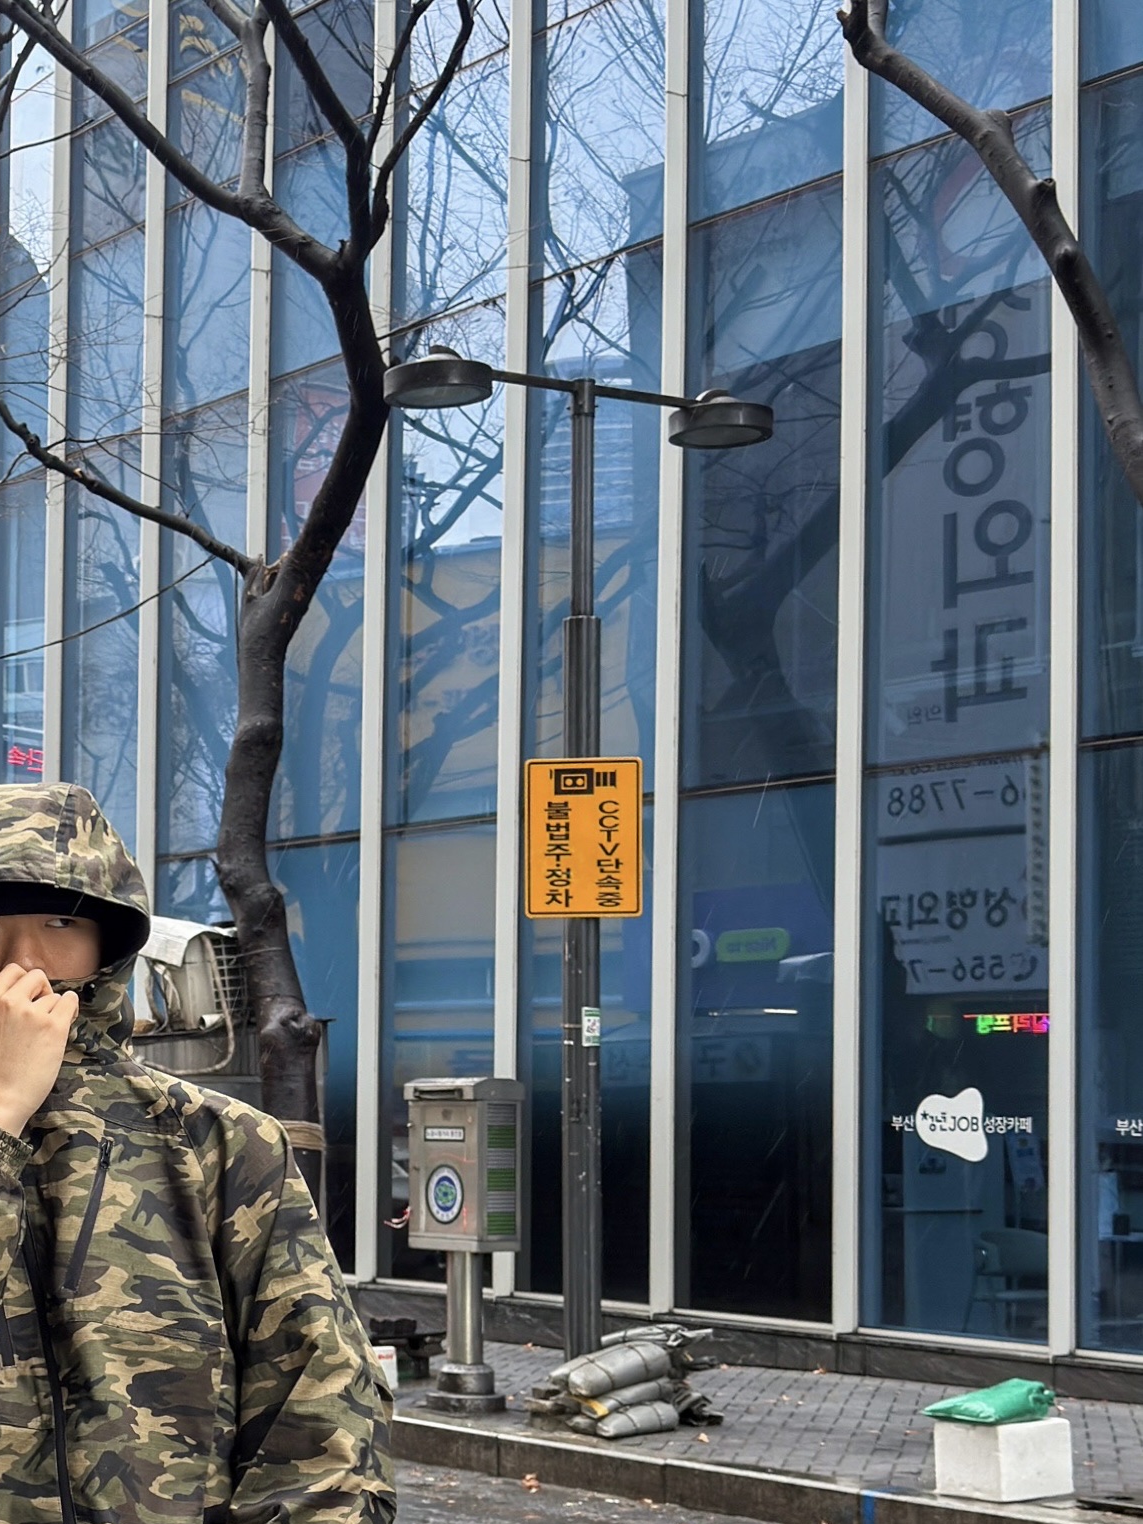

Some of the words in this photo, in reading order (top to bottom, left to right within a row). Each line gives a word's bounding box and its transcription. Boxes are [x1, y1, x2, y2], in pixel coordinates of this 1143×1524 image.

[595, 800, 623, 907] CCTV단속중
[891, 1115, 914, 1132] 부산
[983, 1115, 1032, 1134] 성장카페
